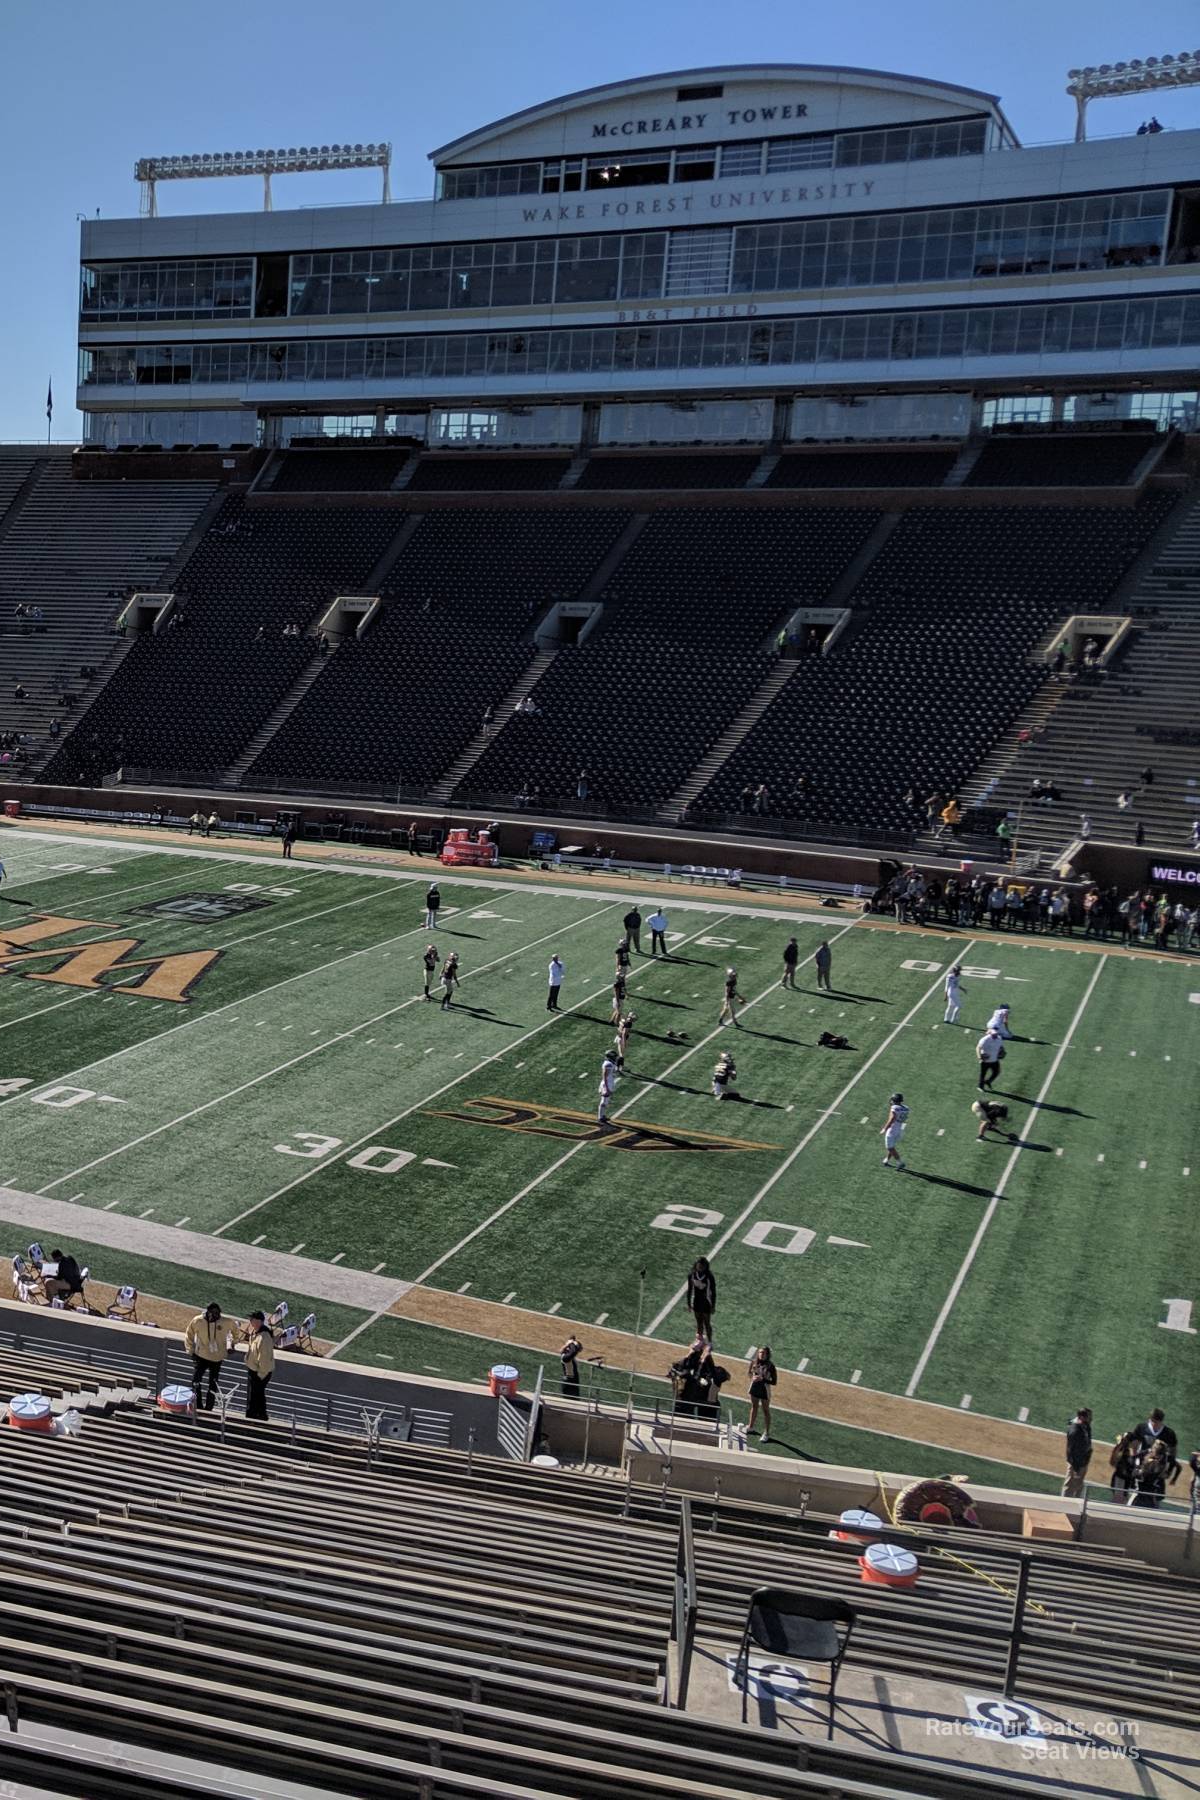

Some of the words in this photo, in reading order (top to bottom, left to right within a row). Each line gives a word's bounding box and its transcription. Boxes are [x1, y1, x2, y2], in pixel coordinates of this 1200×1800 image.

[592, 114, 707, 138] McCREARY
[728, 104, 809, 124] TOWER
[522, 204, 586, 223] WAKE
[602, 196, 692, 217] FOREST
[710, 180, 877, 208] UNIVERSITY
[618, 310, 673, 321] BB&T
[693, 304, 759, 317] FIELD
[273, 1132, 416, 1175] 30
[650, 1204, 817, 1255] 20
[1158, 1298, 1198, 1334] 1
